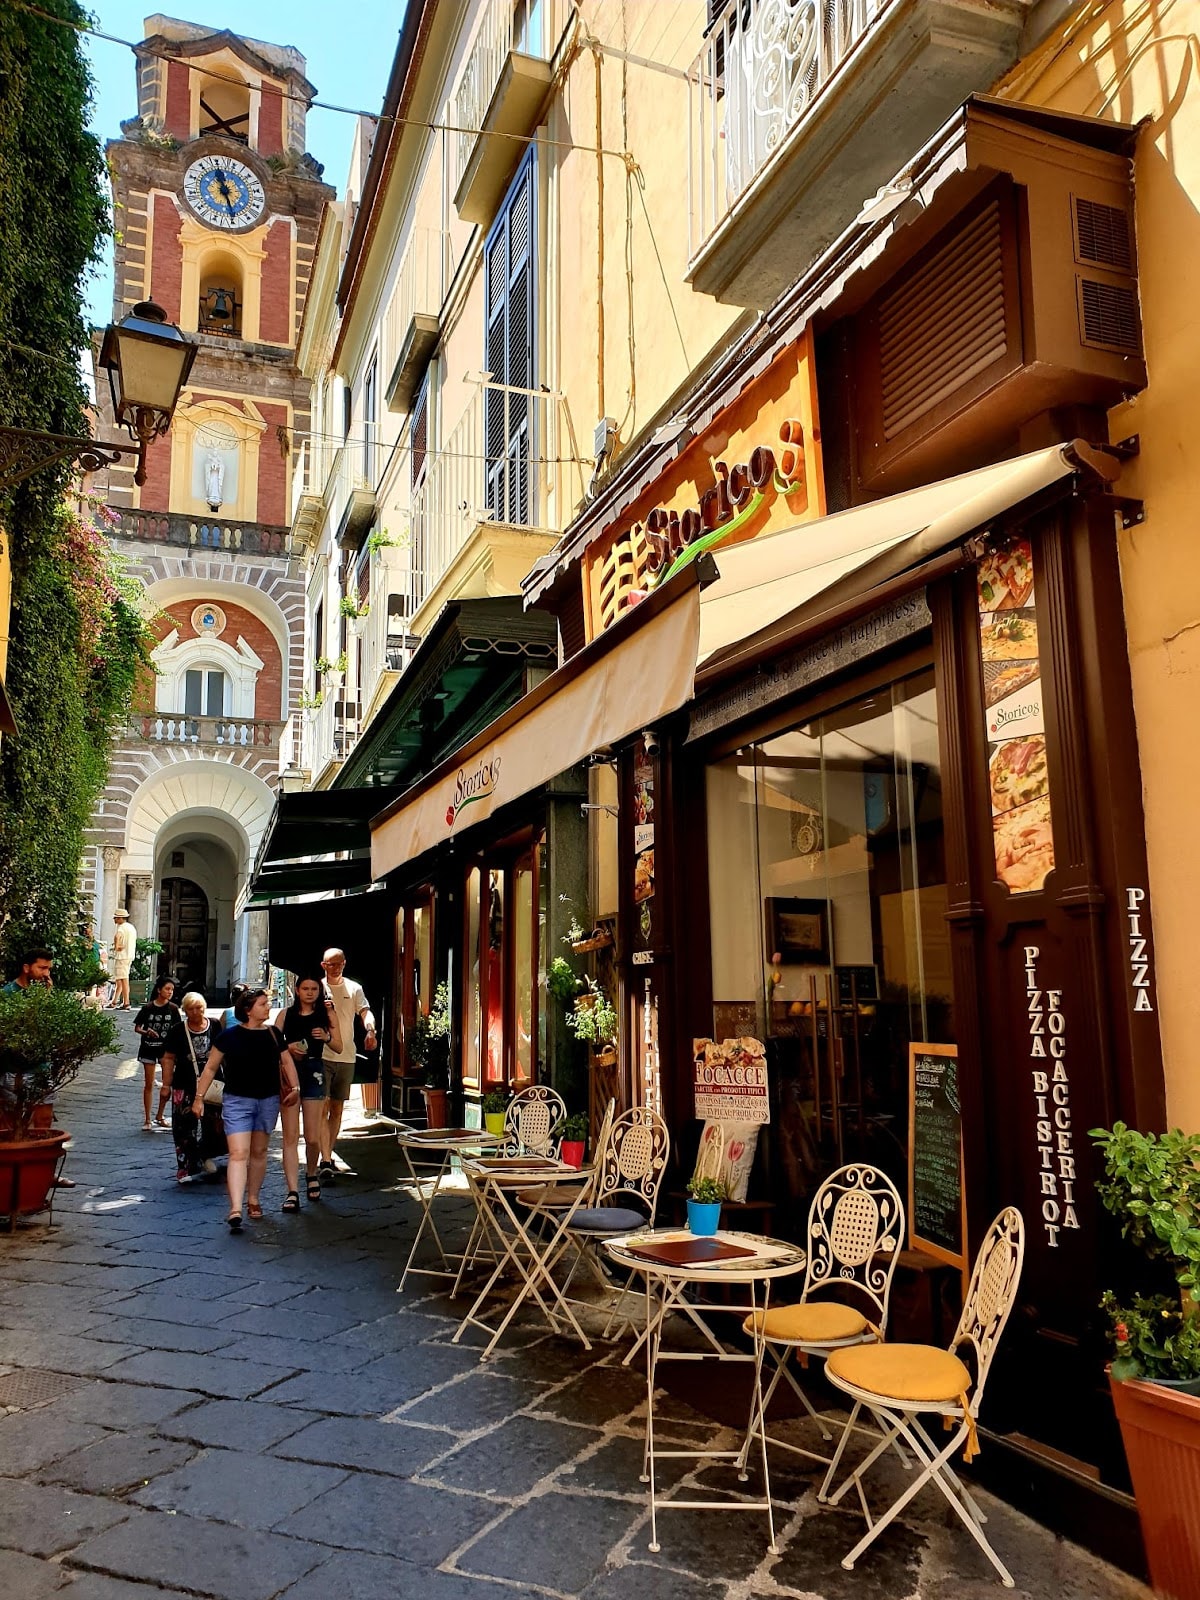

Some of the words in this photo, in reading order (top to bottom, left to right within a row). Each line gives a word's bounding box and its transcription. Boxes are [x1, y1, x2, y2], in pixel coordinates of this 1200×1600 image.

[802, 645, 829, 666] slice
[832, 631, 845, 653] of
[1024, 946, 1047, 1058] PIZZA
[1126, 887, 1153, 1012] PIZZA
[694, 1061, 765, 1085] FOCACCE
[1046, 989, 1080, 1229] FOCACCERIA
[1032, 1070, 1059, 1247] BISTROT
